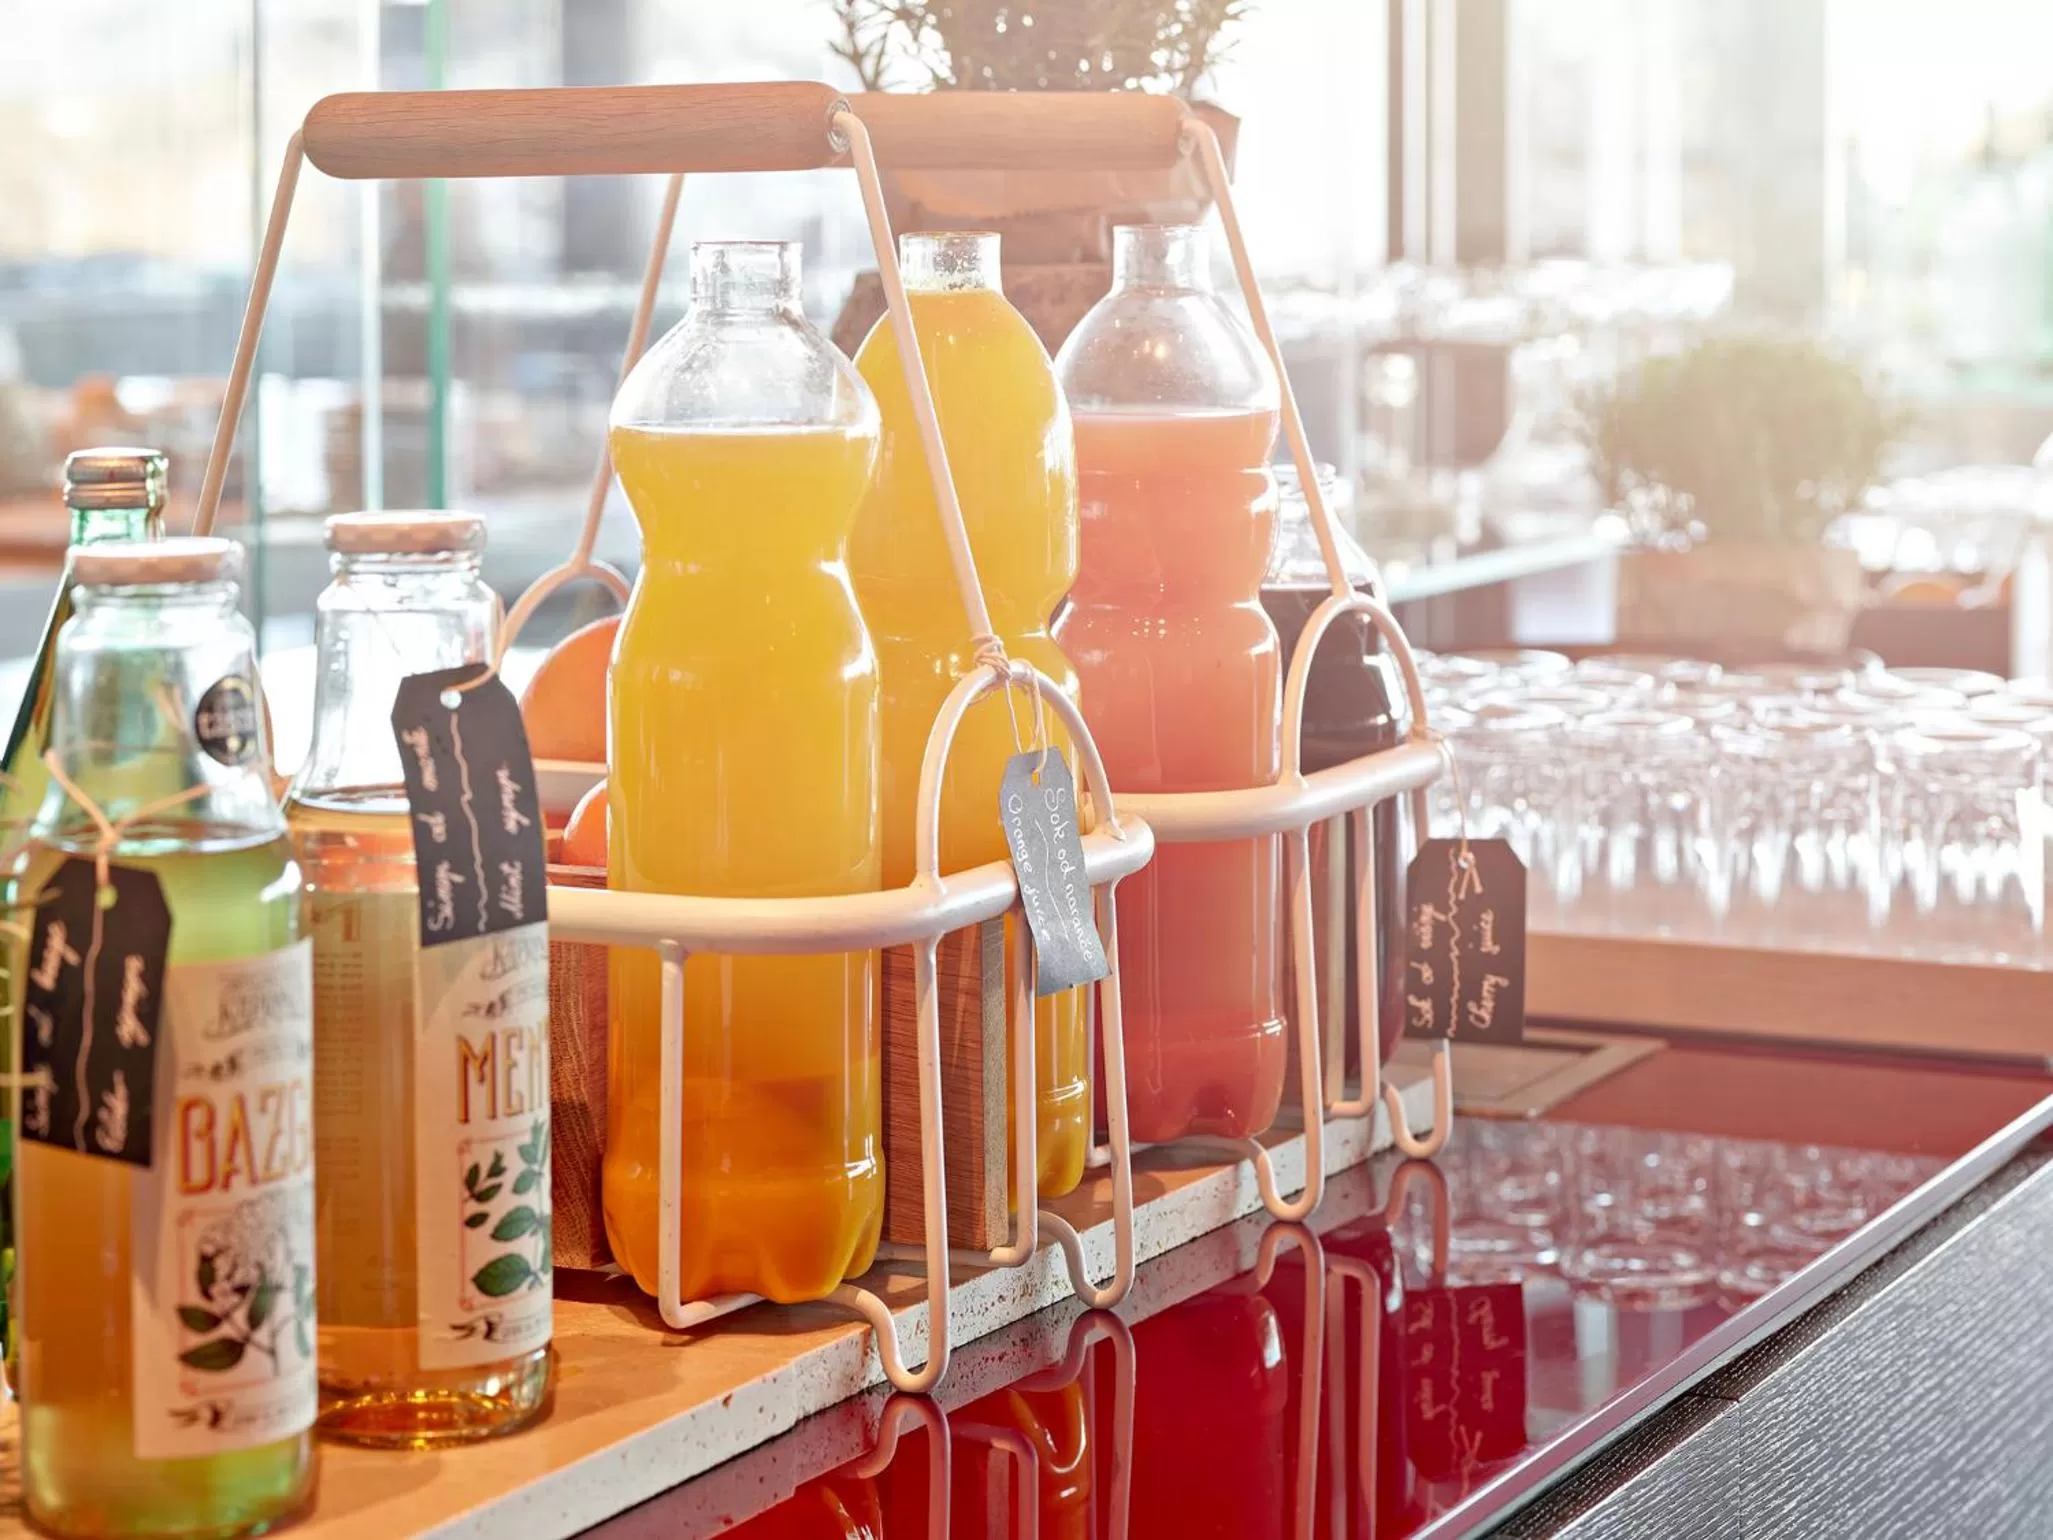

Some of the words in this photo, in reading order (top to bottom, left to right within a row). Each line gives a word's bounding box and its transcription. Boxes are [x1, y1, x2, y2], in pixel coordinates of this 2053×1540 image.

[1008, 793, 1034, 874] Orange
[1044, 787, 1070, 845] Sok
[1057, 847, 1076, 880] od
